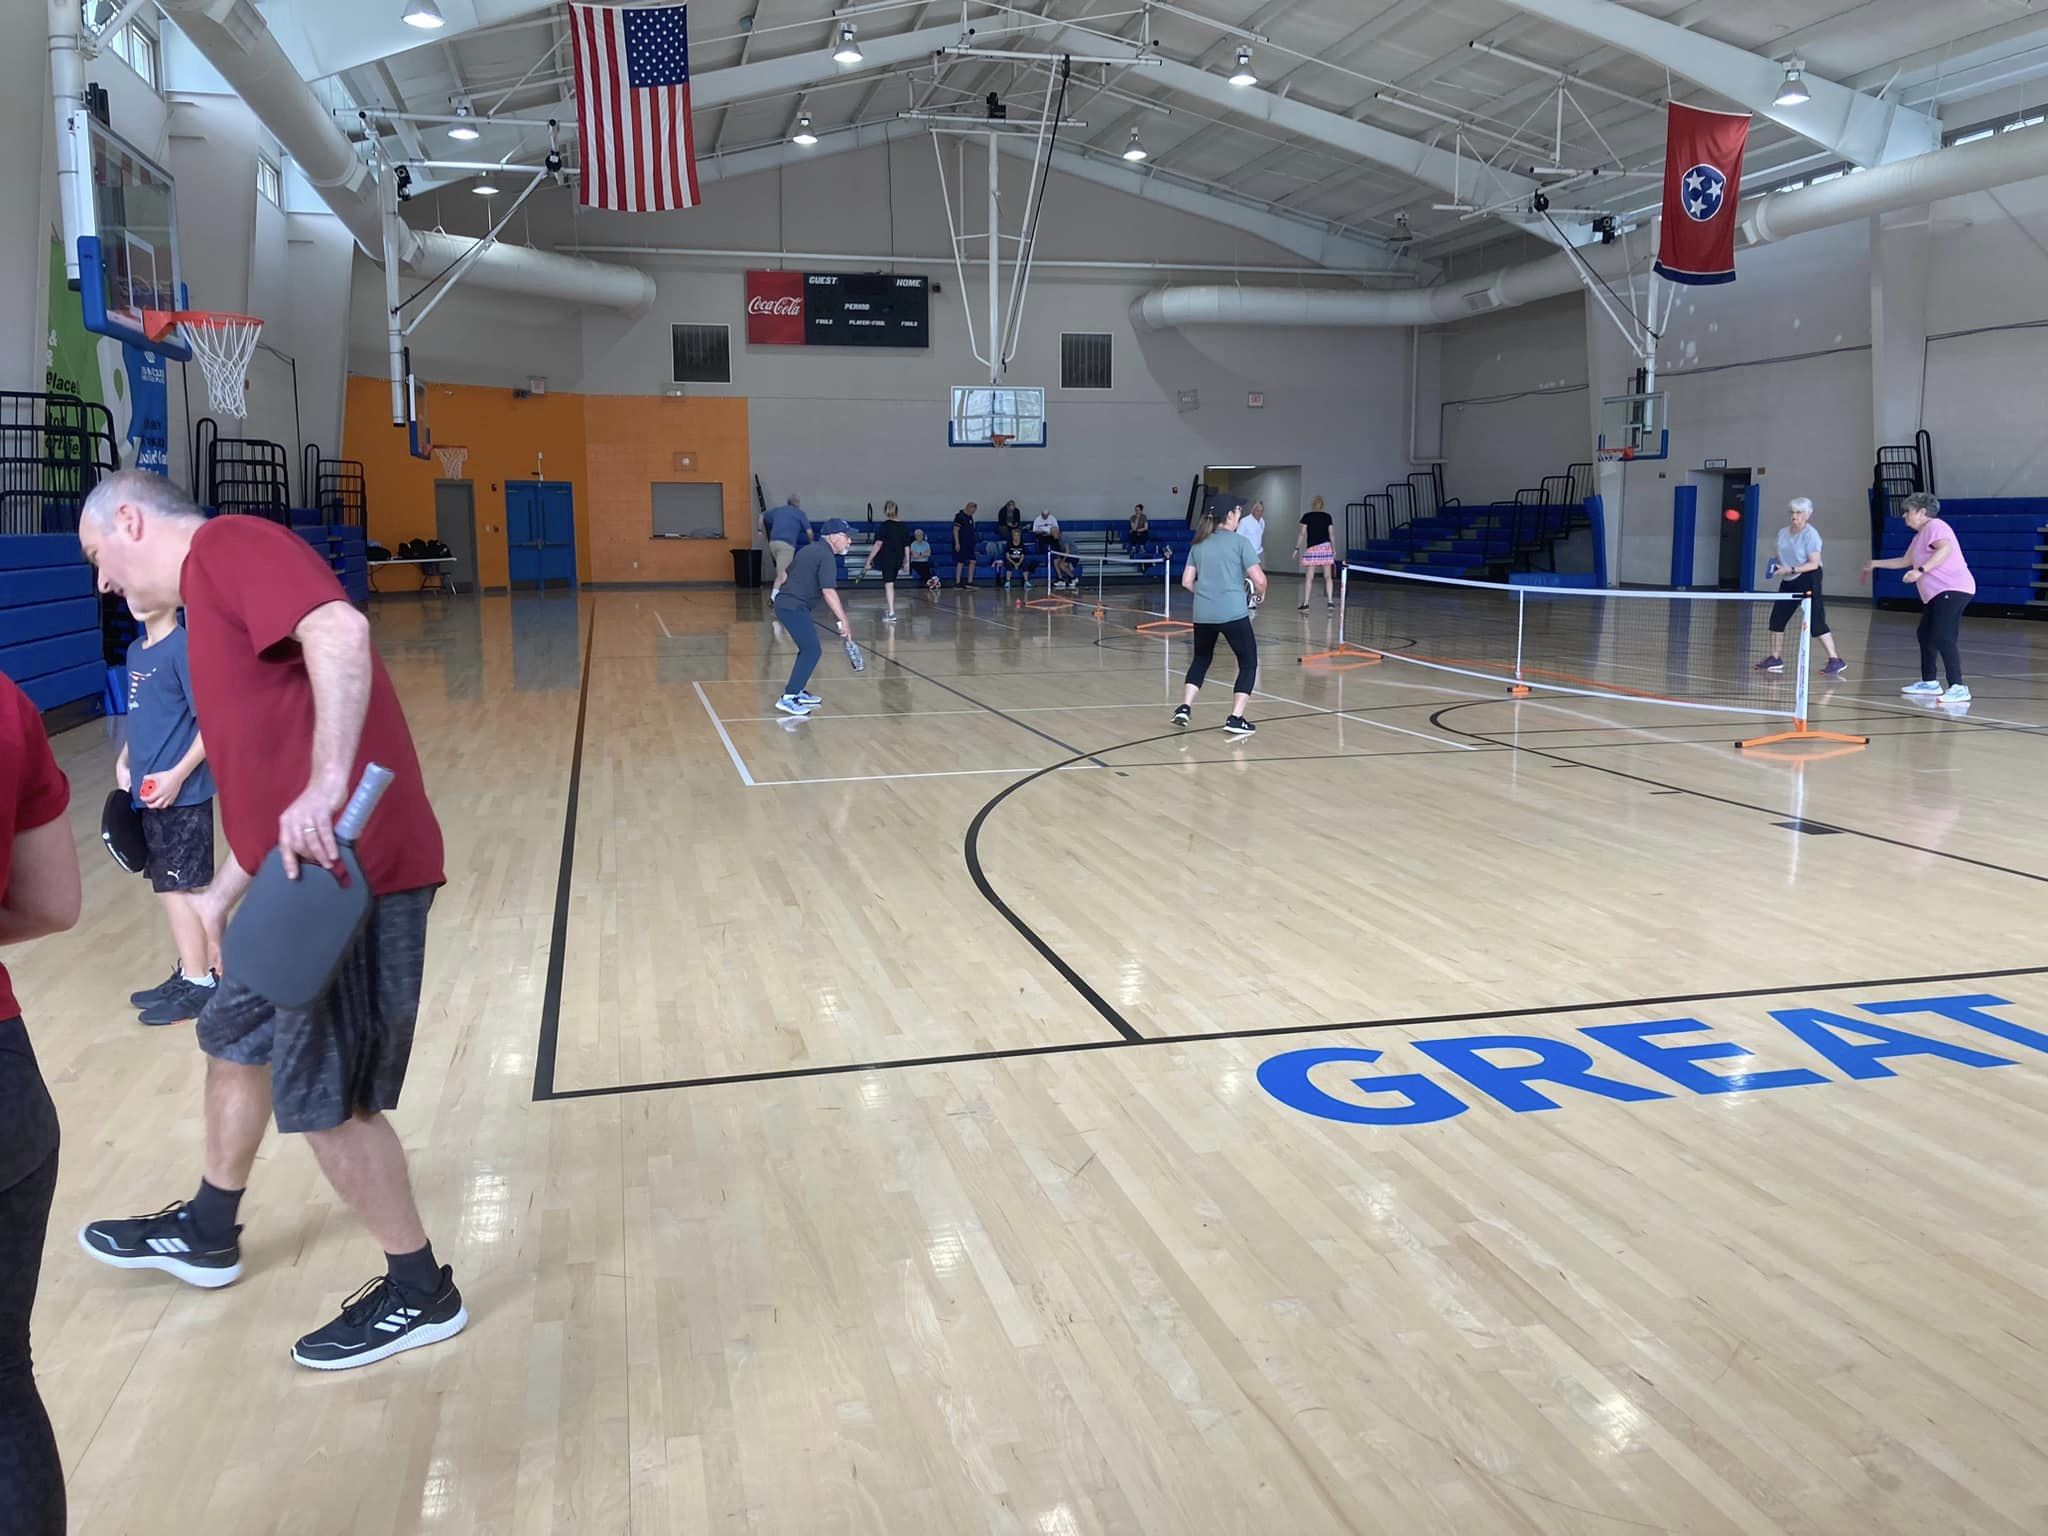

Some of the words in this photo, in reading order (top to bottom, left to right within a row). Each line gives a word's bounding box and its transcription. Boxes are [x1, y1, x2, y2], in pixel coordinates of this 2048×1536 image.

[808, 276, 838, 285] GUEST
[896, 278, 921, 287] HOME
[1256, 993, 2048, 1126] GREAT
